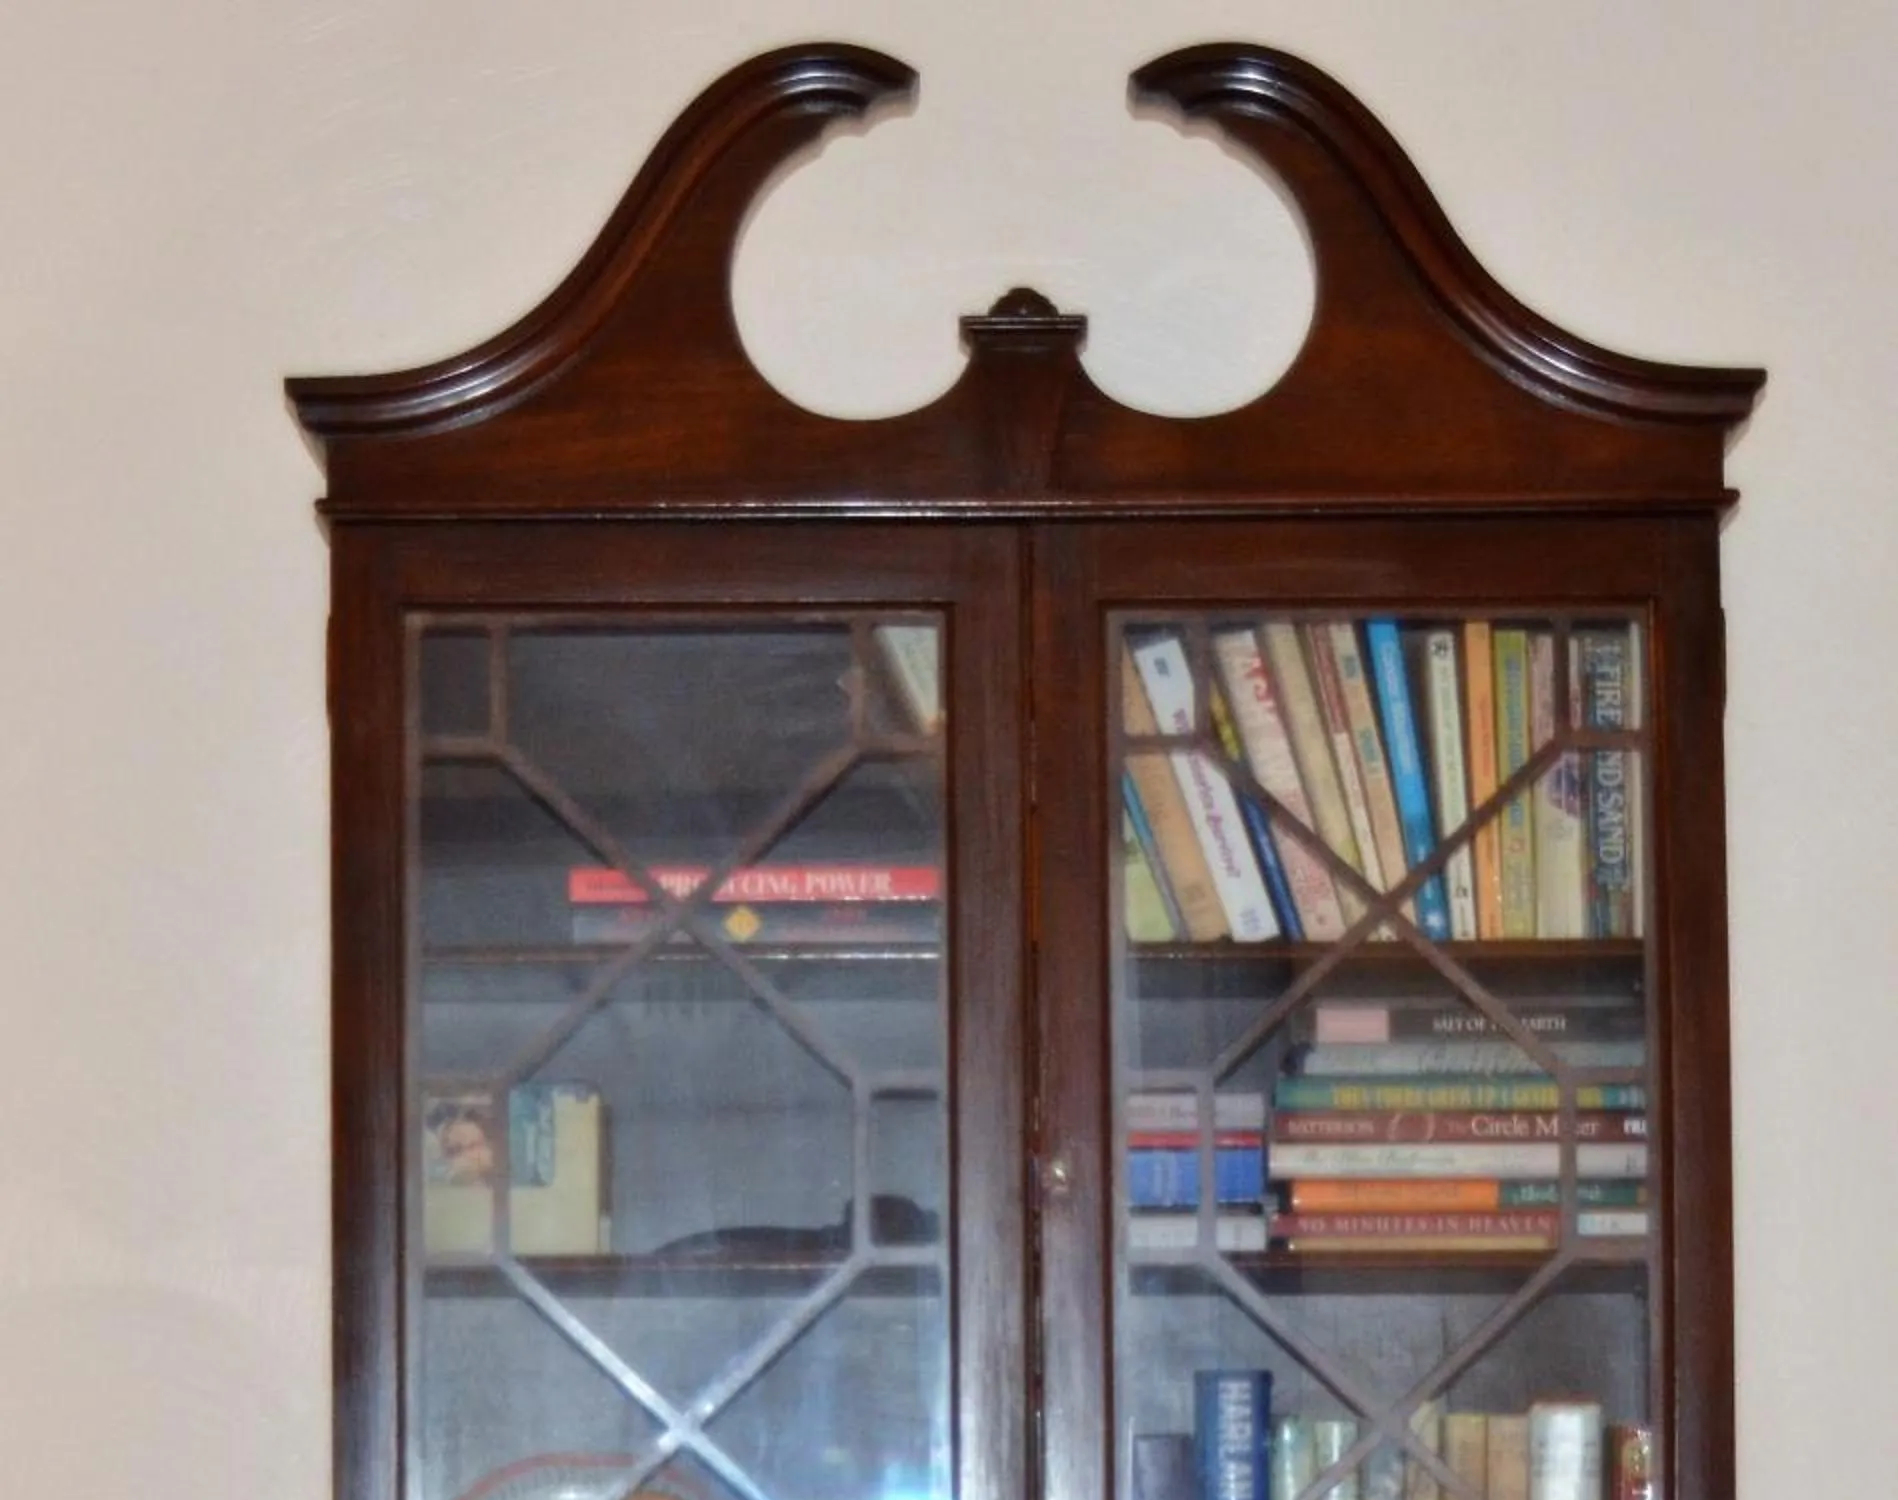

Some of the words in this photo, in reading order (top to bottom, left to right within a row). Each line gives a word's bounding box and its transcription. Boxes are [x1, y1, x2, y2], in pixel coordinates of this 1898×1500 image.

[1595, 663, 1623, 723] FIRE
[1596, 736, 1624, 787] ND
[1596, 791, 1625, 865] SAND
[804, 872, 892, 896] POWER
[1470, 1114, 1524, 1137] Circle
[1535, 1115, 1602, 1137] Mer
